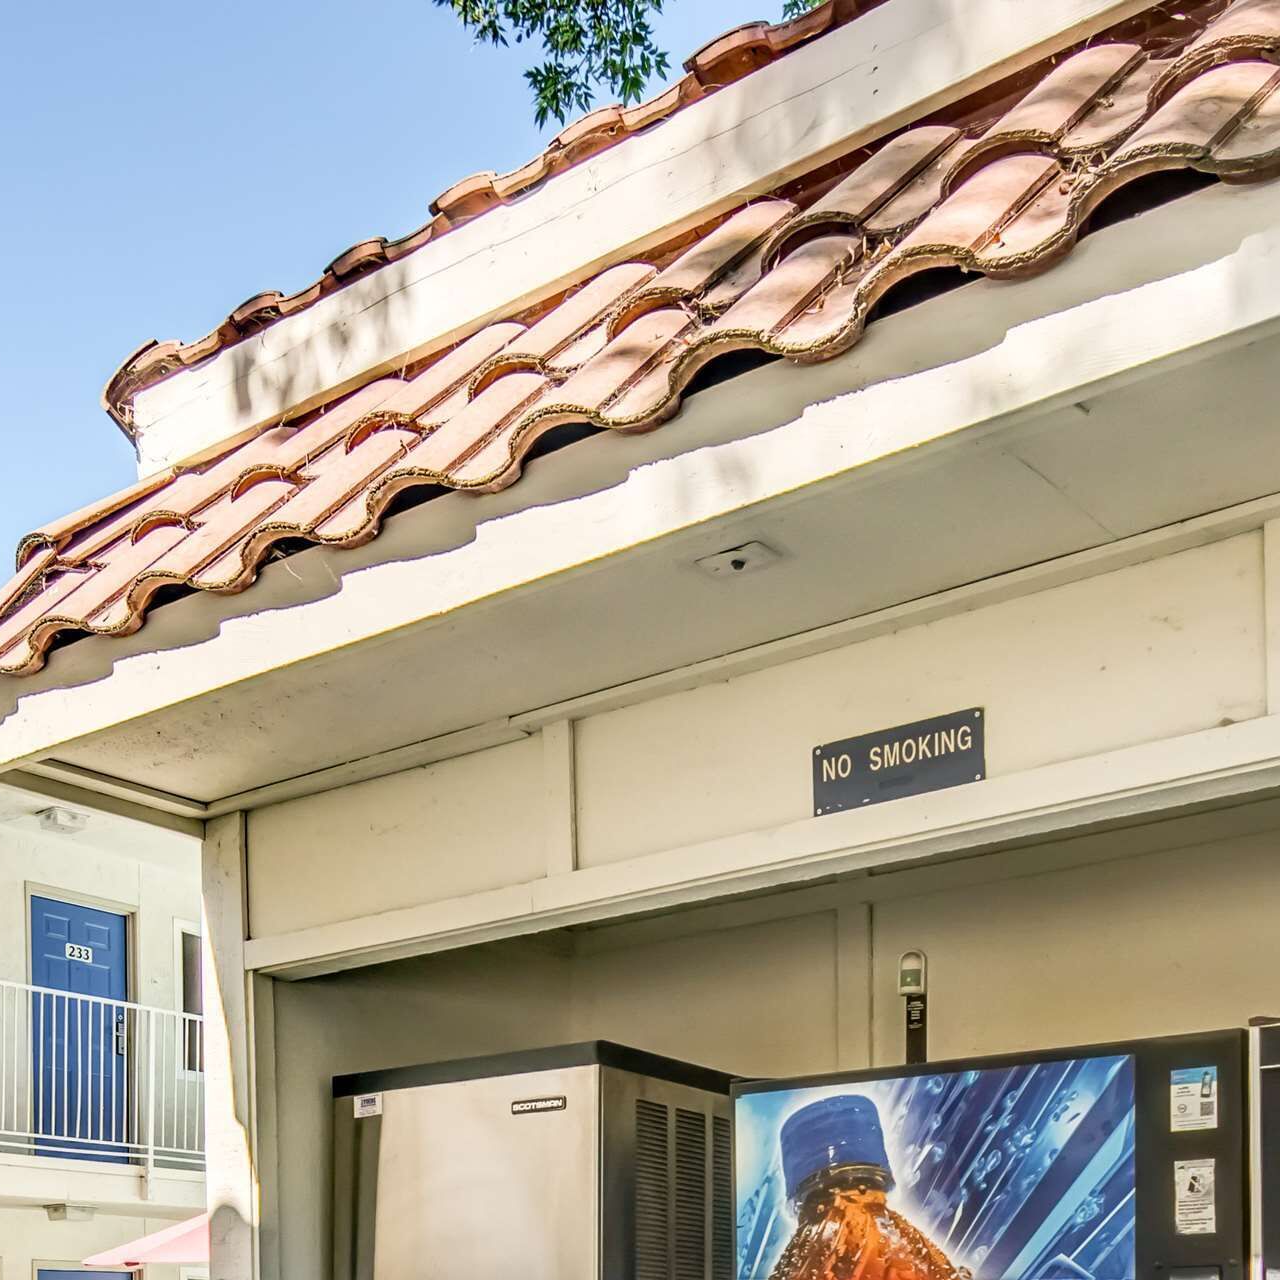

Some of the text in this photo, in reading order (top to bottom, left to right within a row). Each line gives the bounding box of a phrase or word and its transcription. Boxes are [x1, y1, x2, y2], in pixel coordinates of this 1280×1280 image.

[822, 725, 973, 783] NO SMOKING
[68, 944, 91, 961] 233
[511, 1098, 564, 1112] SCOTSMAN
